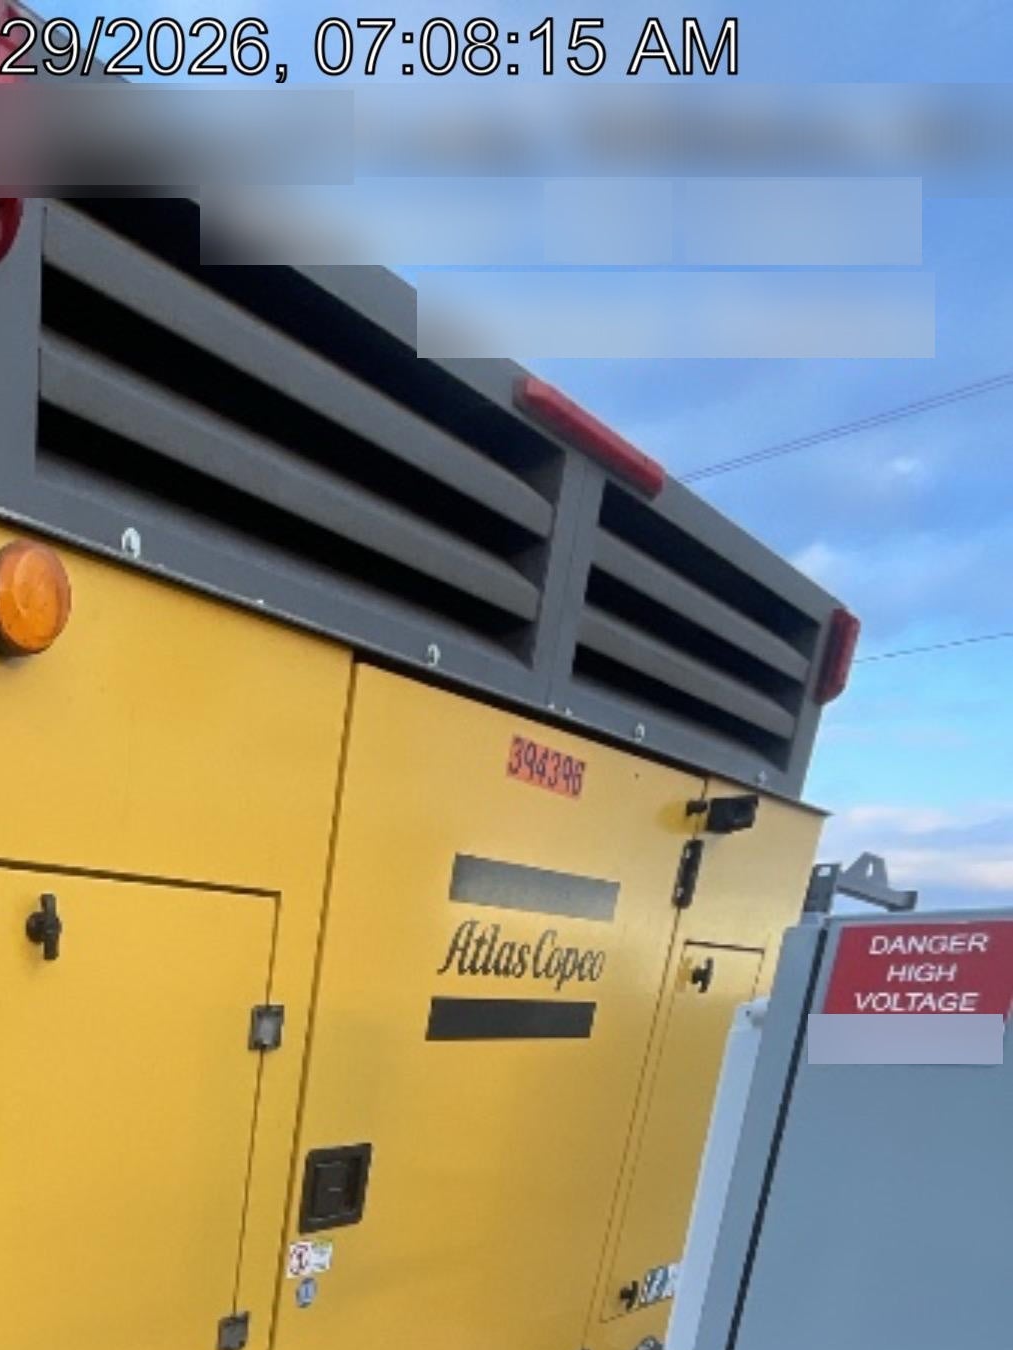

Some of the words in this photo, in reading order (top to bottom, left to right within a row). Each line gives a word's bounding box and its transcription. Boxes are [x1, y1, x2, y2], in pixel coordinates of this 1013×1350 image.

[508, 737, 585, 796] 394396
[437, 919, 531, 979] Atlas
[532, 929, 606, 991] Copco
[869, 933, 989, 955] DANGER
[886, 963, 957, 982] HIGH
[854, 992, 980, 1012] VOLTAGE
